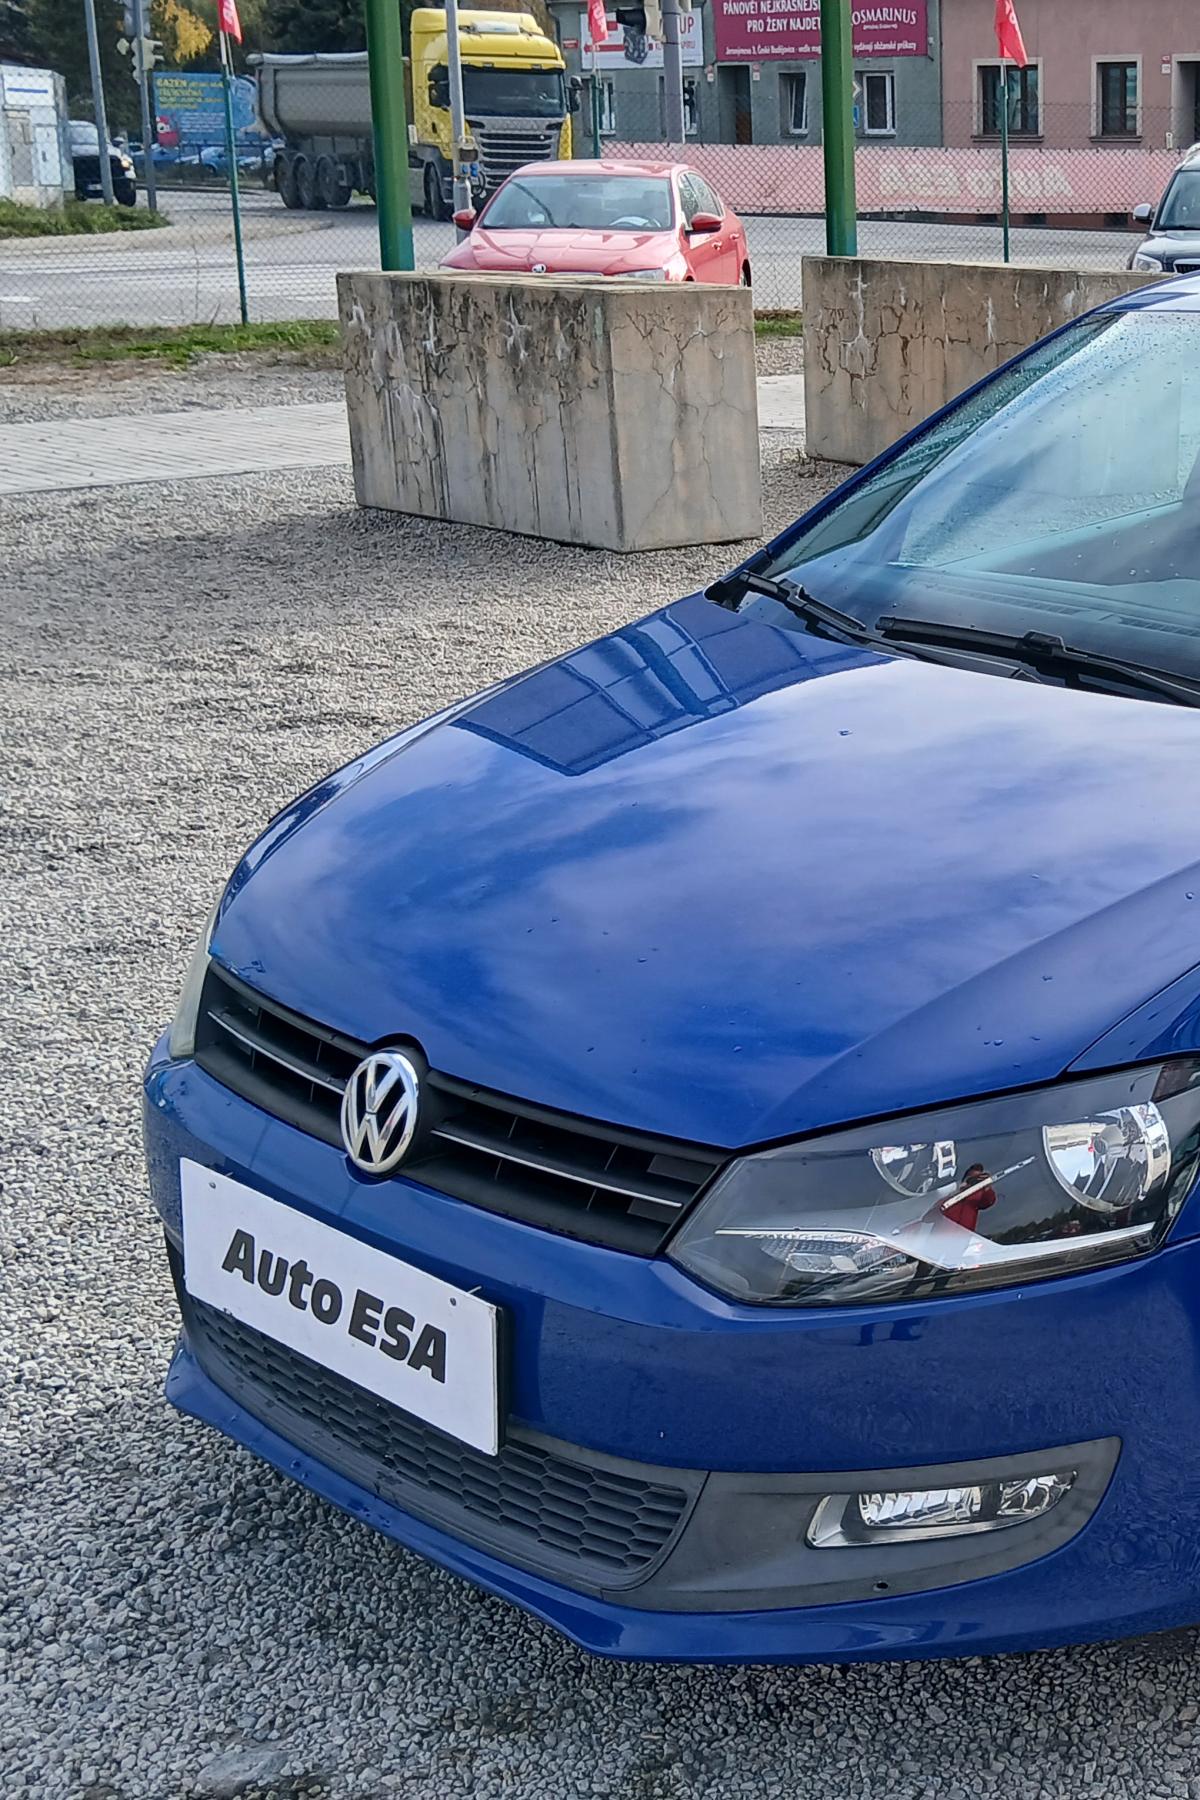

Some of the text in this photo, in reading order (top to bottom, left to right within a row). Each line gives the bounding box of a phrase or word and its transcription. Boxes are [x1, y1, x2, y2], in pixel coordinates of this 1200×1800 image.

[680, 16, 694, 33] UP
[747, 16, 821, 32] PRO ŽENY NAJDET
[851, 8, 917, 25] OSMARINUS
[221, 1228, 447, 1384] Auto ESA
